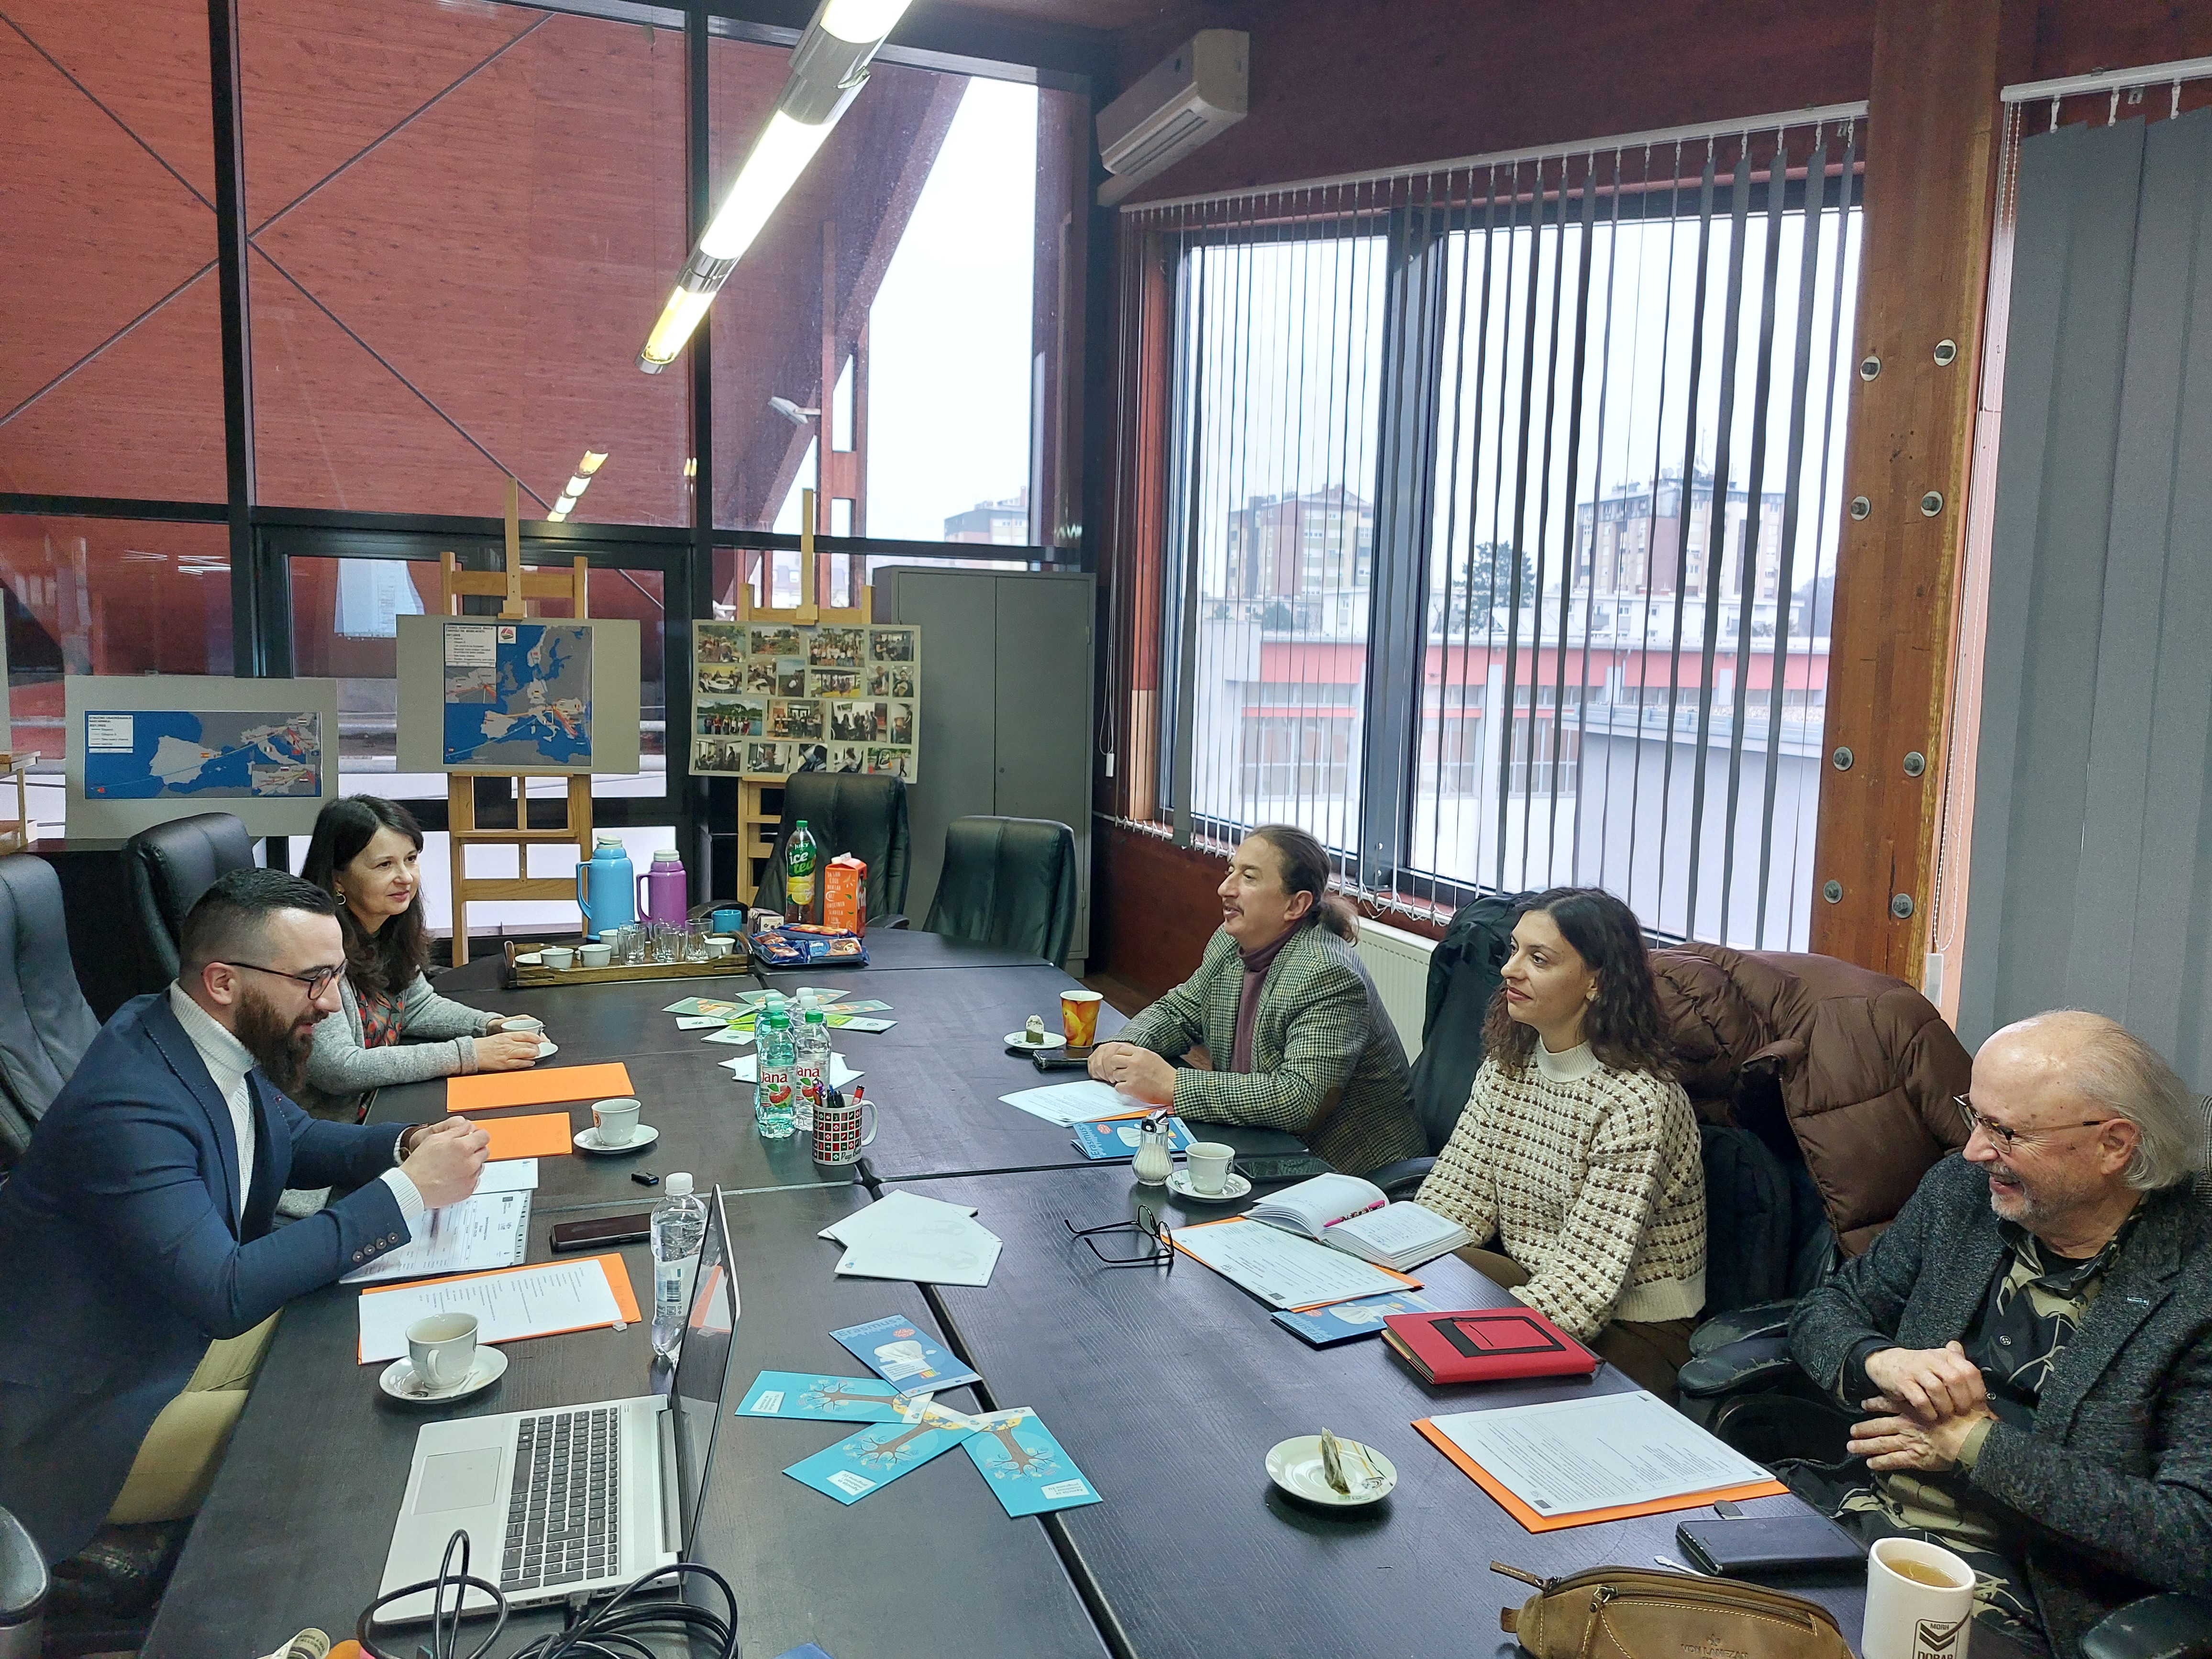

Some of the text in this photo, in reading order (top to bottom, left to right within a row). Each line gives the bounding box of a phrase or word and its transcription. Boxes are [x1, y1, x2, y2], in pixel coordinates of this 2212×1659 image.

[789, 852, 808, 865] ice
[794, 860, 814, 874] tea
[761, 1072, 788, 1084] Jana
